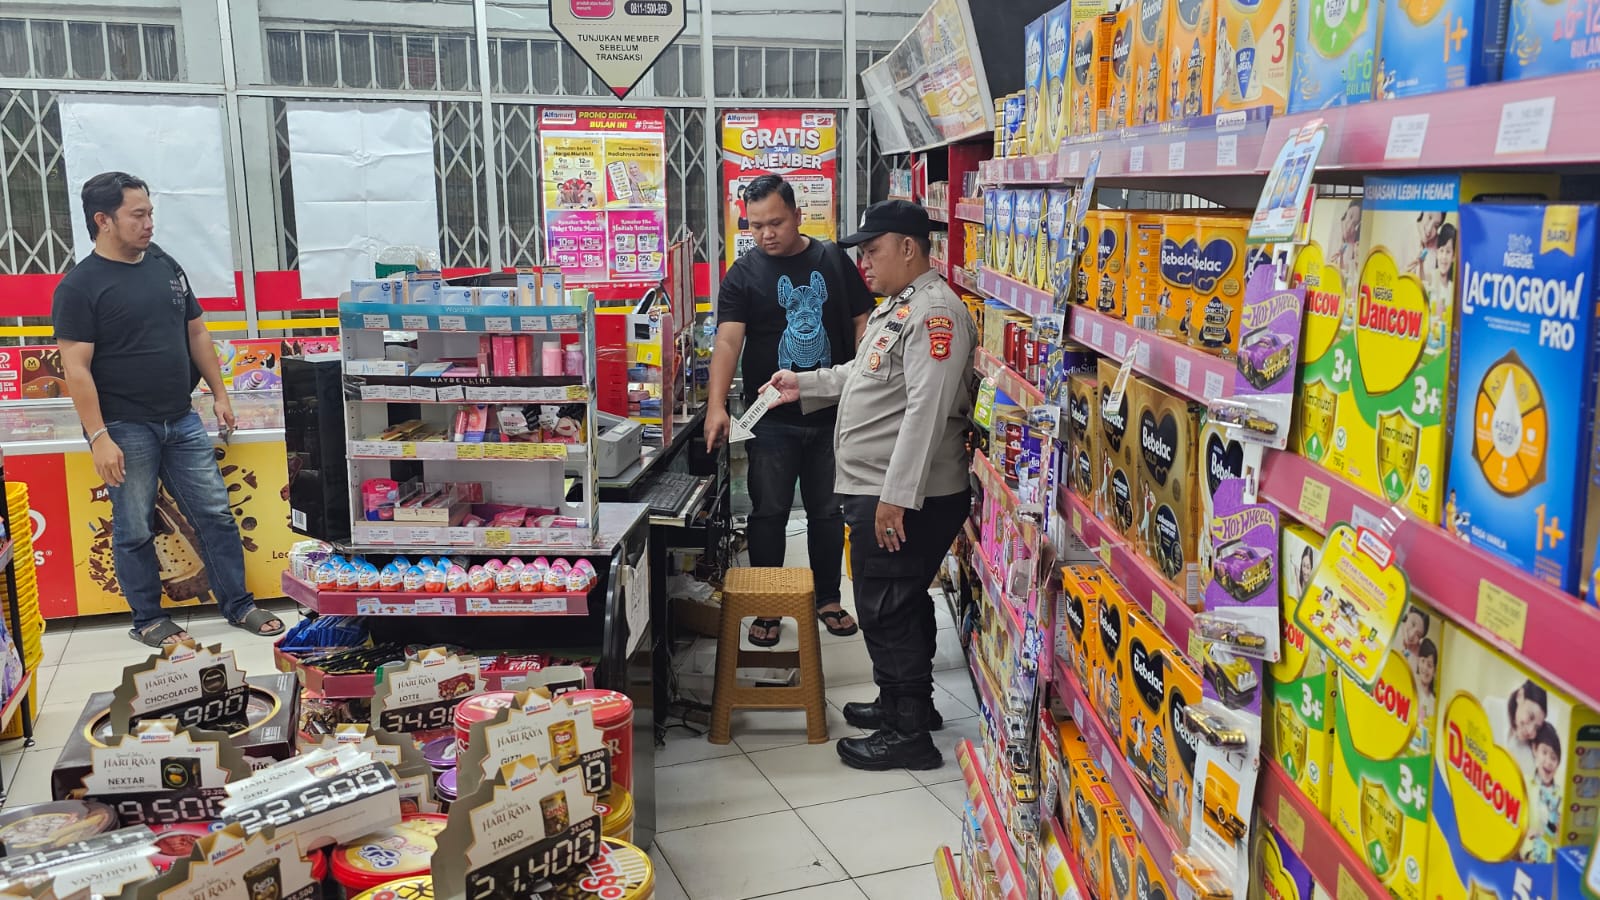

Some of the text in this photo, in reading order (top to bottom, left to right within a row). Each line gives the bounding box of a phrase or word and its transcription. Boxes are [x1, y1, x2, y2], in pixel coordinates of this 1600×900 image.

[577, 34, 622, 42] TUNJUKAN
[1270, 23, 1286, 64] 3
[596, 53, 643, 61] TRANSAKSI
[1346, 81, 1371, 97] BULAN
[579, 111, 637, 120] PROMO DIGITAL
[589, 121, 628, 129] BULAN INI
[741, 127, 820, 150] GRATIS
[1364, 183, 1456, 201] KEMASAN LEBIH HEMAT
[1546, 230, 1571, 243] BARU
[1462, 261, 1584, 320] LACTOGROW
[1252, 295, 1298, 327] HOT WHEELS
[1358, 284, 1423, 341] Dancow
[1539, 319, 1575, 351] PRO
[1411, 375, 1441, 415] 3+
[1142, 425, 1172, 462] Bebelac
[1223, 509, 1273, 540] HOT WHEELS
[1535, 503, 1566, 551] 1+
[145, 672, 189, 690] HARI RAYA
[398, 675, 437, 689] HARI RAYA
[1133, 651, 1164, 695] Bebelac
[144, 685, 199, 705] CHOCOLATOS
[1301, 683, 1324, 722] 3+
[524, 702, 551, 712] Alfamart
[497, 728, 543, 748] HARI RAYA
[104, 758, 156, 769] HARI RAYA
[107, 776, 145, 786] NEXTAR
[510, 771, 537, 788] Alfamart
[1449, 720, 1522, 829] Dancow
[1397, 763, 1427, 811] 3+
[482, 804, 532, 833] HARI RAYA
[491, 830, 525, 851] TANGO
[211, 841, 244, 861] Alfamart
